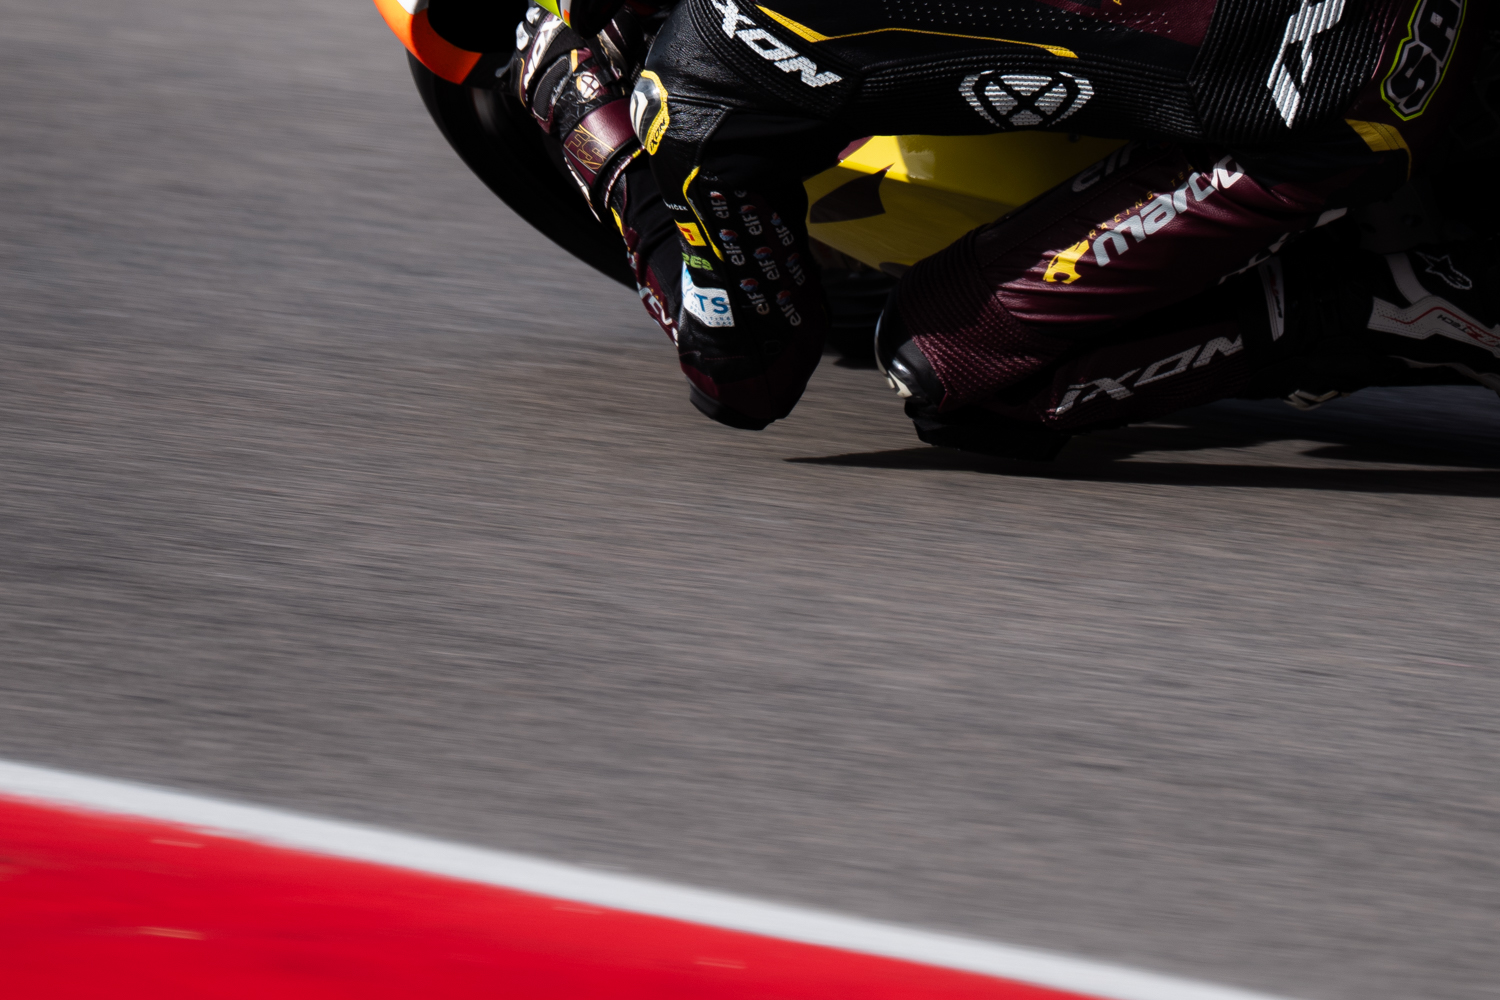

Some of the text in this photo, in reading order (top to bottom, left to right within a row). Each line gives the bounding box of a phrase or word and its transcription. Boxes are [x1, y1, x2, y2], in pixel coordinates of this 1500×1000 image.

[711, 196, 730, 220] elf
[1088, 190, 1154, 239] RACING
[1170, 163, 1195, 188] TEA
[741, 213, 763, 236] elf
[1092, 171, 1215, 267] marc
[725, 242, 746, 267] elf
[759, 258, 781, 281] elf
[746, 292, 770, 316] elf
[781, 304, 802, 327] elf
[1055, 333, 1245, 415] IXON
